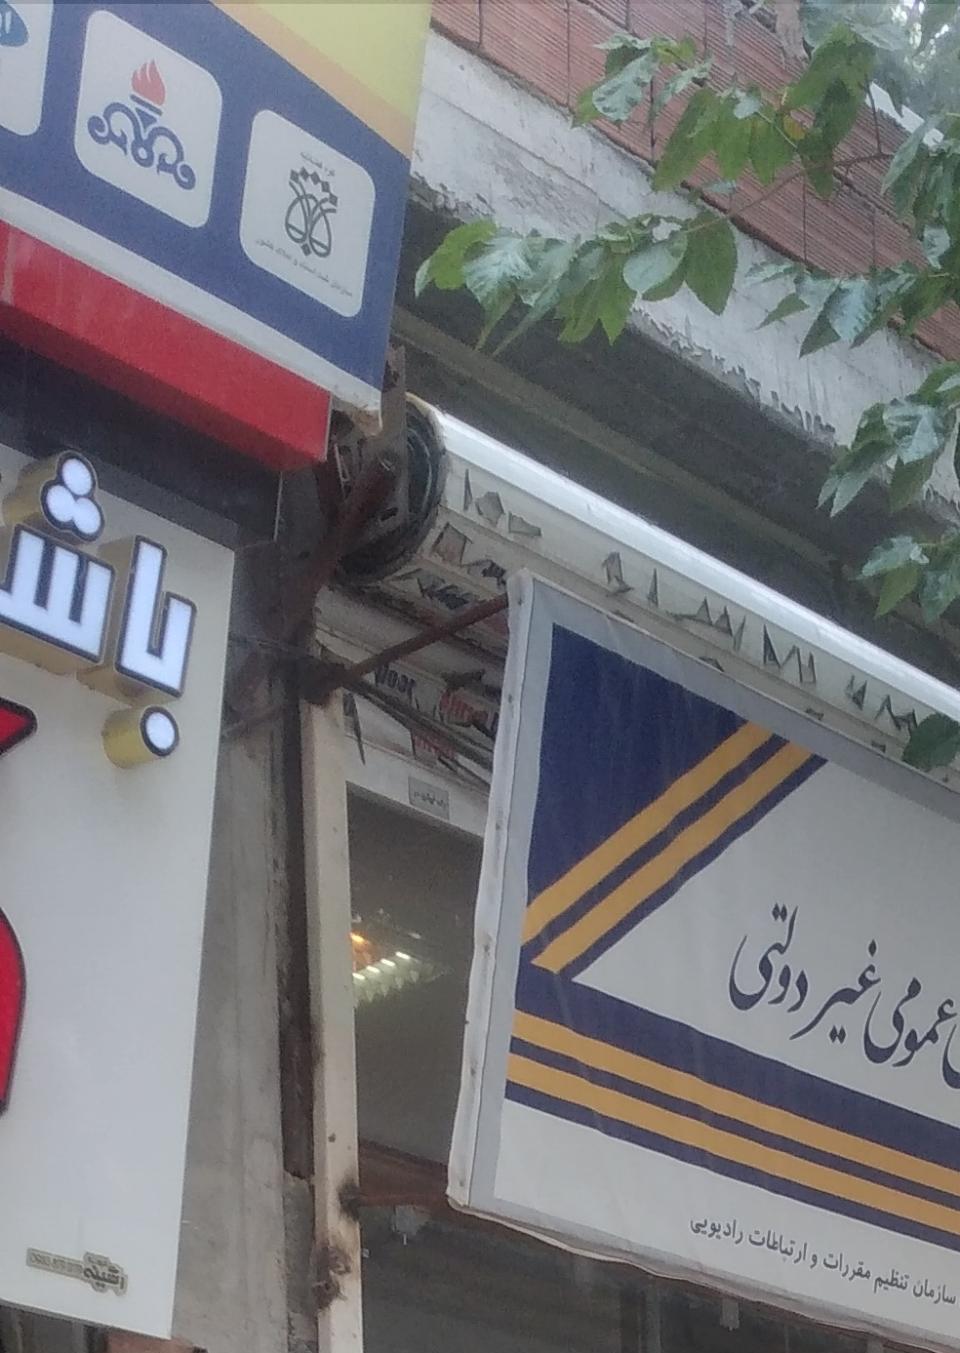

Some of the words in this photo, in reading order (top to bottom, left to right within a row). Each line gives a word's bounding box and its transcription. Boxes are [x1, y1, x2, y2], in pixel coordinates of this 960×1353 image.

[0, 450, 198, 757] باش
[728, 902, 808, 1013] دولتی
[788, 938, 882, 1045] غیر
[863, 976, 958, 1068] عمومی
[690, 1218, 744, 1244] رادیویی
[749, 1229, 808, 1264] ارتباطات
[810, 1252, 818, 1269] و
[823, 1252, 871, 1281] مقررات
[873, 1269, 910, 1293] تنظیم
[913, 1279, 956, 1305] سازمان
